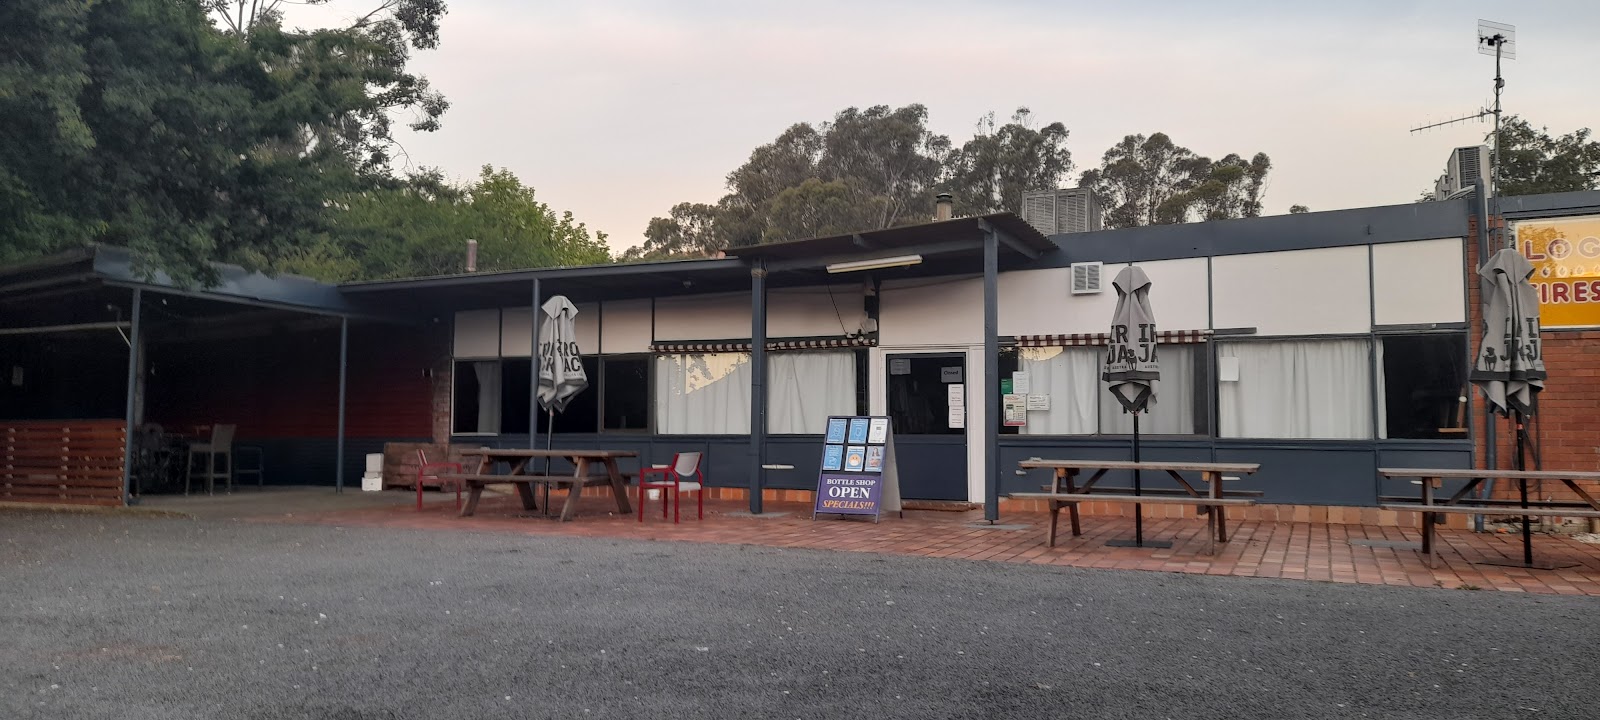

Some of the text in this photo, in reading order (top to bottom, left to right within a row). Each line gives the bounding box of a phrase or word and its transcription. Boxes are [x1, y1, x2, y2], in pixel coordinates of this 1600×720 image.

[1524, 237, 1600, 260] LOG
[1532, 280, 1600, 303] IRES
[828, 486, 871, 499] OPEN
[822, 500, 875, 509] SPECIALS!!!
